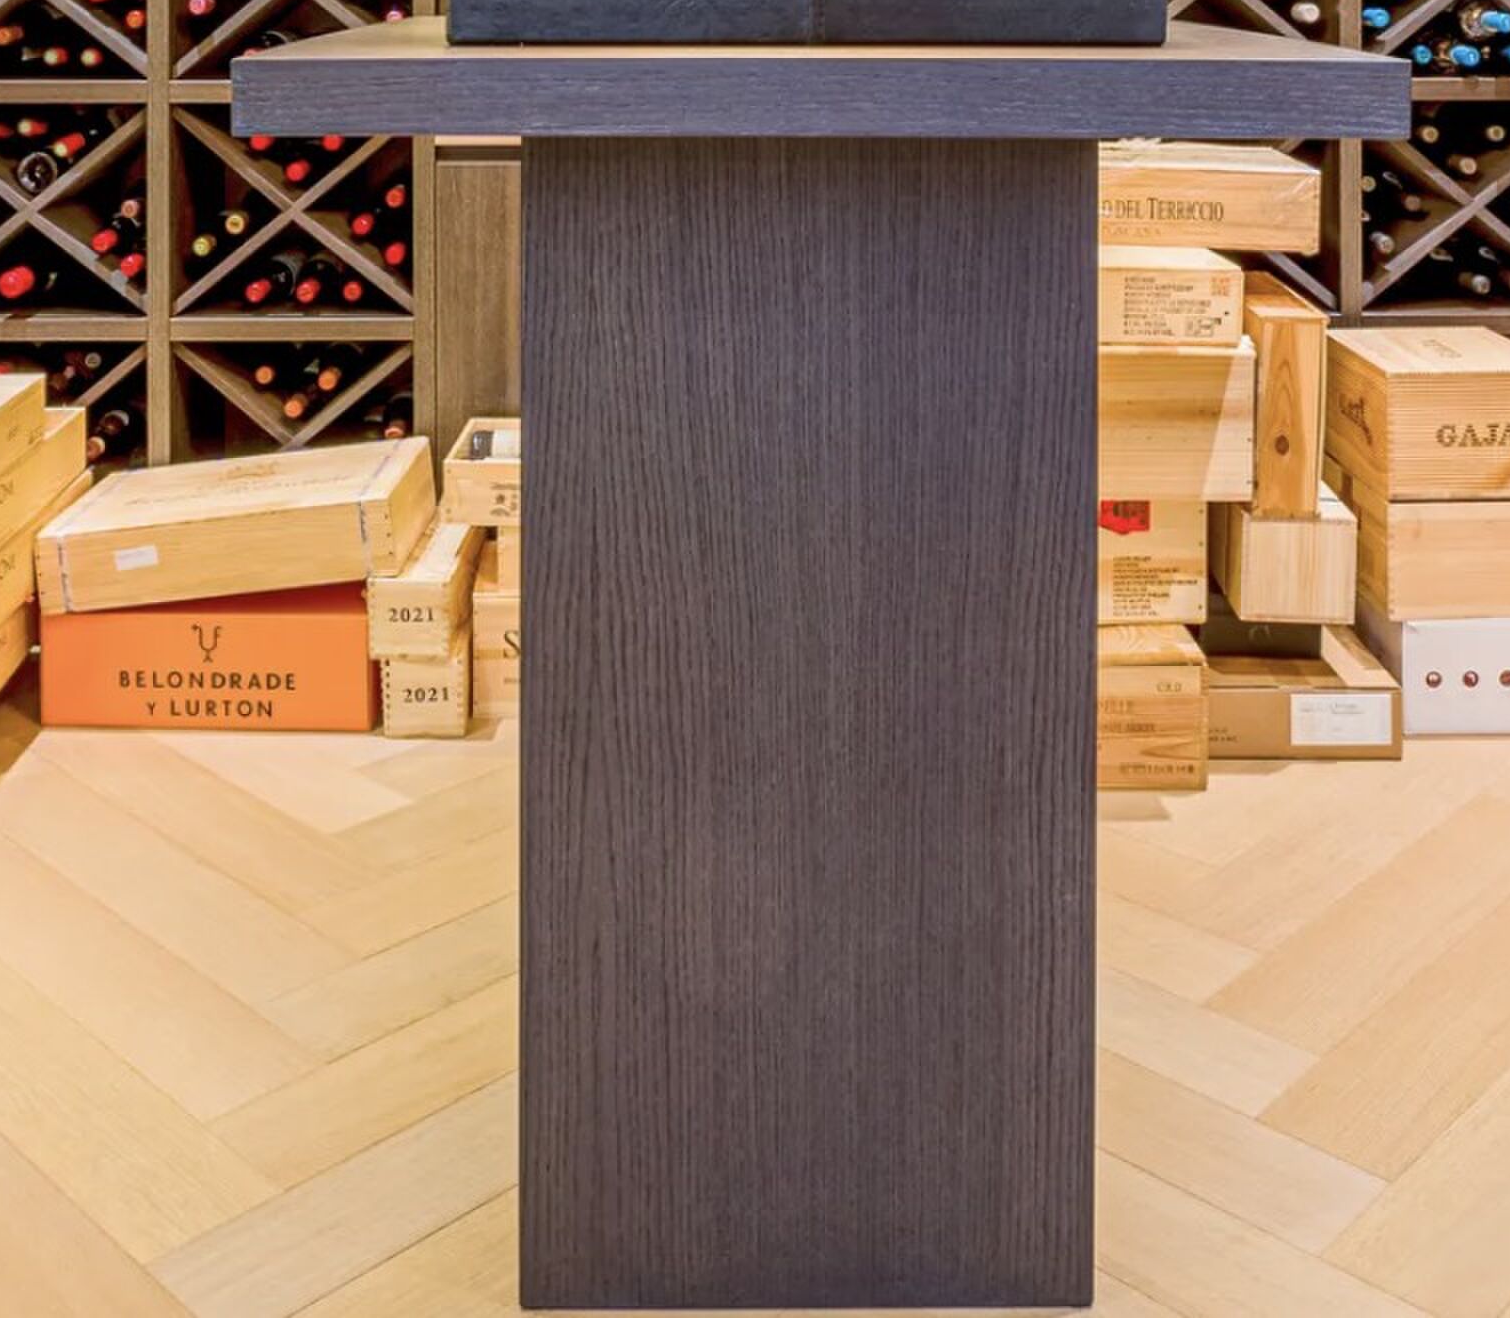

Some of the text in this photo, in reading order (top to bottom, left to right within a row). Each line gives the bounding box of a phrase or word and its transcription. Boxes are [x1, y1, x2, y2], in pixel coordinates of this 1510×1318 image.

[1146, 197, 1224, 222] TERRICCIO
[388, 607, 435, 623] 2021
[118, 669, 297, 692] BELONDRADE
[402, 687, 450, 703] 2021
[145, 699, 274, 719] Y LURTON
